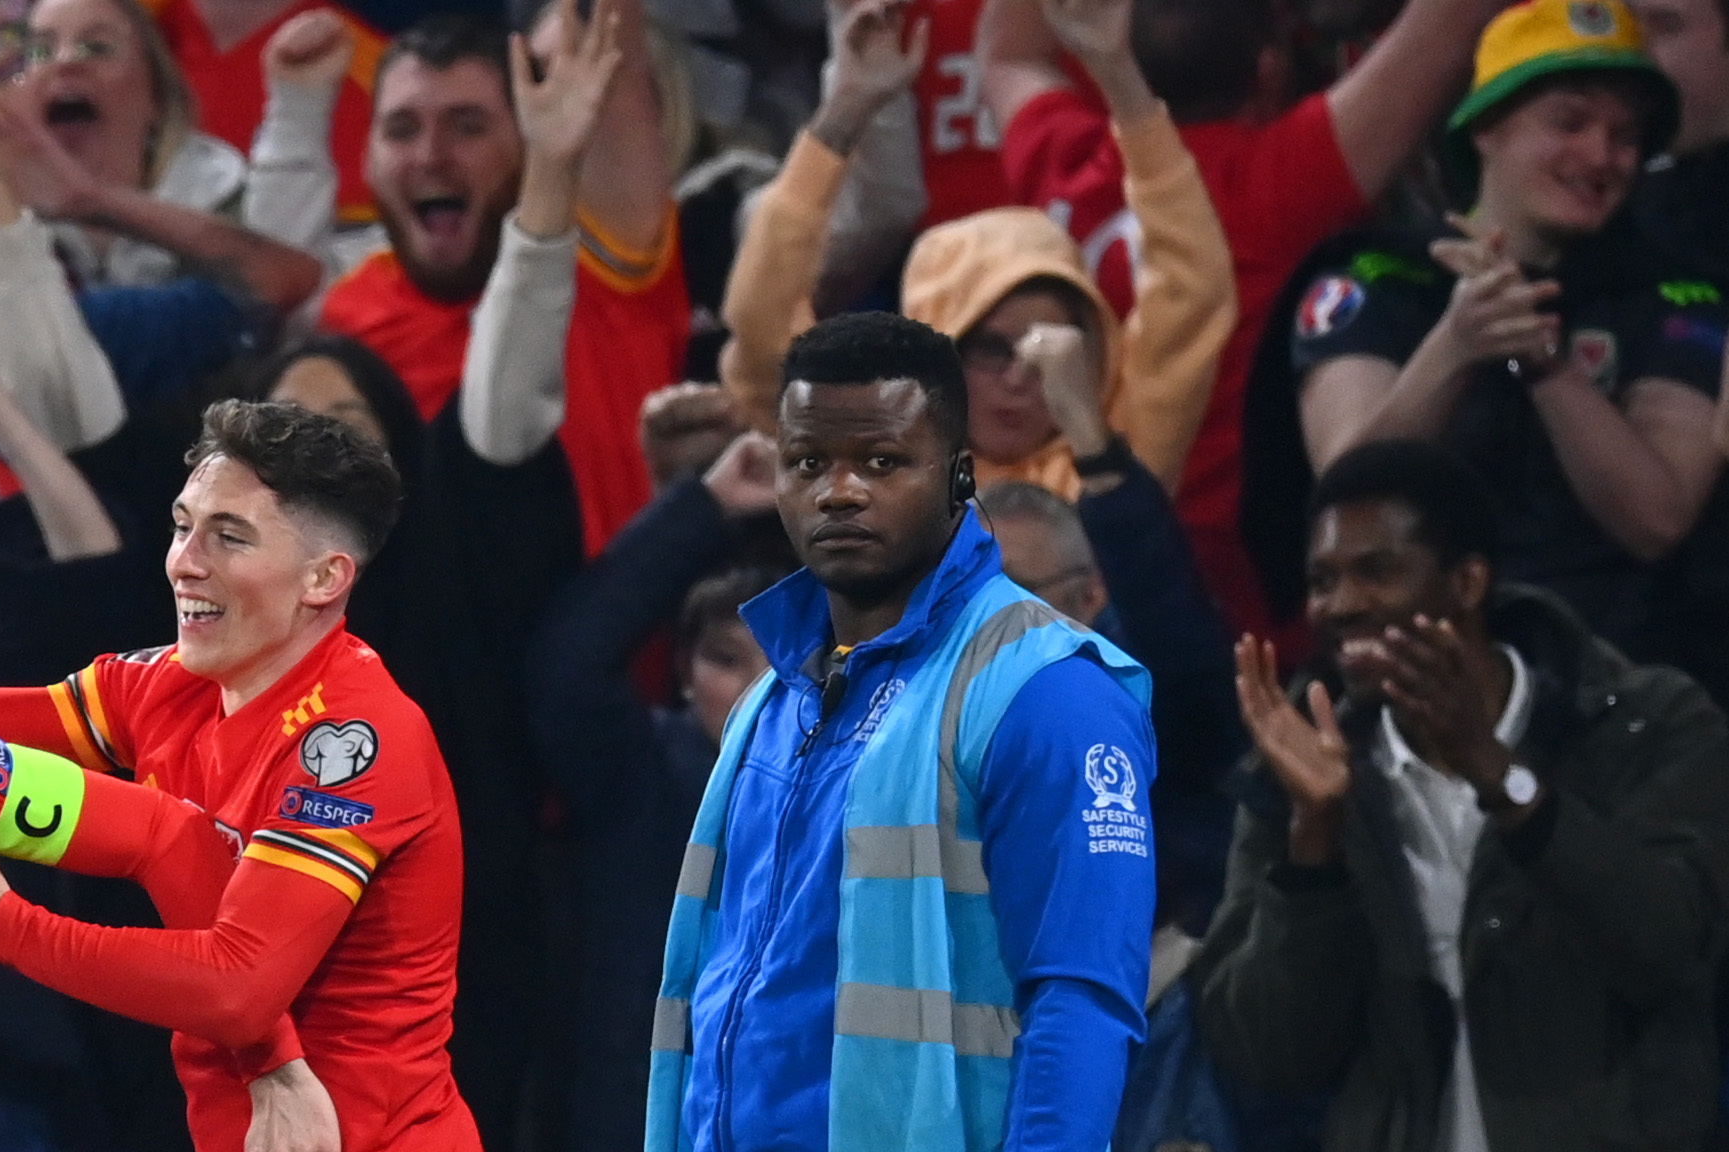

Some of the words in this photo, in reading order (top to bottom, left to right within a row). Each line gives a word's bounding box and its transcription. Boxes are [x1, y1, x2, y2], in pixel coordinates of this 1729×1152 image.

[15, 796, 63, 838] C
[302, 800, 372, 826] RESPECT
[1082, 809, 1147, 829] SAFESTYLE
[1088, 824, 1145, 841] SECURITY
[1089, 840, 1148, 858] SERVICES
